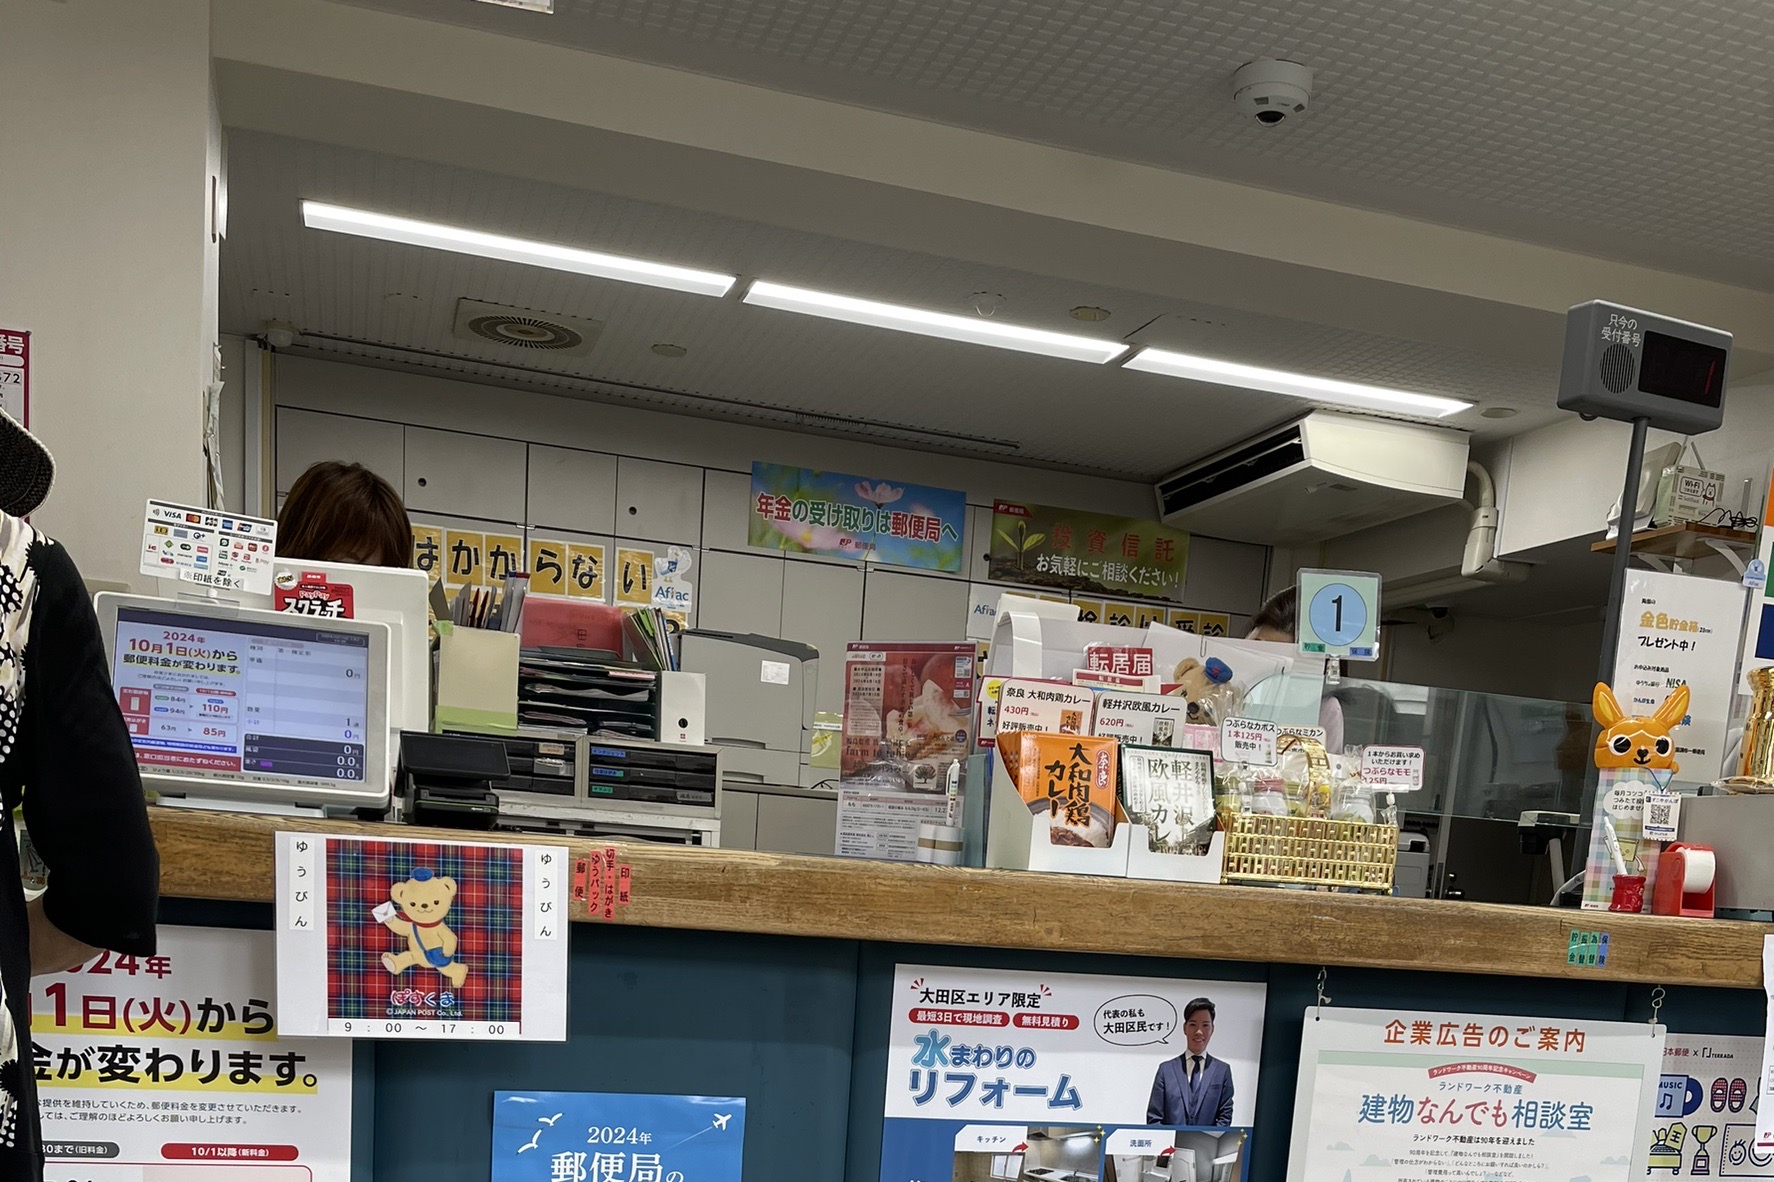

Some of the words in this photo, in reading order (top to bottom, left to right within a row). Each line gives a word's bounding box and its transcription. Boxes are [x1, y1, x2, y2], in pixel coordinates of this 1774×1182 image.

[1608, 313, 1637, 330] 只今の
[1601, 327, 1642, 348] 受付番号
[1684, 479, 1701, 490] Wi-Fi
[164, 510, 182, 520] VISA
[756, 492, 959, 543] 年金の受け取りは郵便局へ
[855, 541, 876, 551] 郵便局
[1051, 523, 1176, 563] 投資信託
[183, 570, 241, 588] ※印紙を除く
[1036, 553, 1180, 588] お気軽にご相談ください!
[299, 590, 330, 600] PayPay
[655, 585, 690, 601] Aflac
[282, 598, 345, 618] スクラッチ
[1331, 594, 1342, 632] 1
[1639, 610, 1700, 634] 金色貯金箱
[162, 630, 206, 644] 2024年
[1638, 635, 1697, 652] プレゼント中!
[129, 638, 239, 661] 10月1日(火)から
[123, 653, 241, 675] 郵便料金が変わります。
[1090, 653, 1153, 676] 転居届
[1006, 687, 1025, 699] 奈良
[1027, 689, 1091, 704] 大和肉鶏カレー
[202, 703, 229, 714] 110円
[1004, 705, 1029, 716] 430円
[1102, 698, 1180, 714] 軽井沢欧風カレー
[1099, 717, 1125, 728] 620円
[1225, 718, 1275, 733] つぶらなカボス
[203, 727, 226, 738] 85円
[1227, 730, 1263, 742] 1本125円
[1276, 727, 1324, 738] つぶらなミカン
[1234, 741, 1262, 751] 販売中!
[1367, 750, 1421, 760] 1本からお買い求め
[1371, 758, 1412, 766] いただけます!
[1363, 766, 1411, 778] つぶらなモモ
[1044, 759, 1068, 818] カレー
[1064, 743, 1091, 826] 大和肉鶏
[1171, 759, 1195, 826] 軽井沢
[293, 840, 309, 928] ゆうびん
[574, 861, 585, 899] 郵便
[589, 853, 600, 914] ゆうパック
[603, 848, 615, 920] 切手・はがき
[619, 866, 631, 904] 印紙
[539, 853, 553, 938] ゆうびん
[1567, 931, 1579, 963] 貯金
[390, 987, 456, 1008] ぽすくま
[919, 987, 1042, 1009] 大田区エリア限定
[916, 1011, 1003, 1025] 最短3日で現地調査
[1021, 1014, 1070, 1028] 無料見積り
[1103, 1008, 1146, 1019] 代表の私も
[1103, 1020, 1171, 1034] 大田区民です!
[1383, 1018, 1586, 1053] 企業広告のご案内
[912, 1028, 1037, 1070] 水まわりの
[908, 1069, 1084, 1112] リフォーム
[1438, 1081, 1524, 1096] ランドワーク不動産
[1358, 1093, 1594, 1131] 建物なんでも相談室
[587, 1126, 653, 1145] 2024年
[976, 1135, 1007, 1144] キッチン
[1129, 1138, 1152, 1148] 洗面所
[1413, 1133, 1536, 1147] ランドワーク不動産は90年を迎えました
